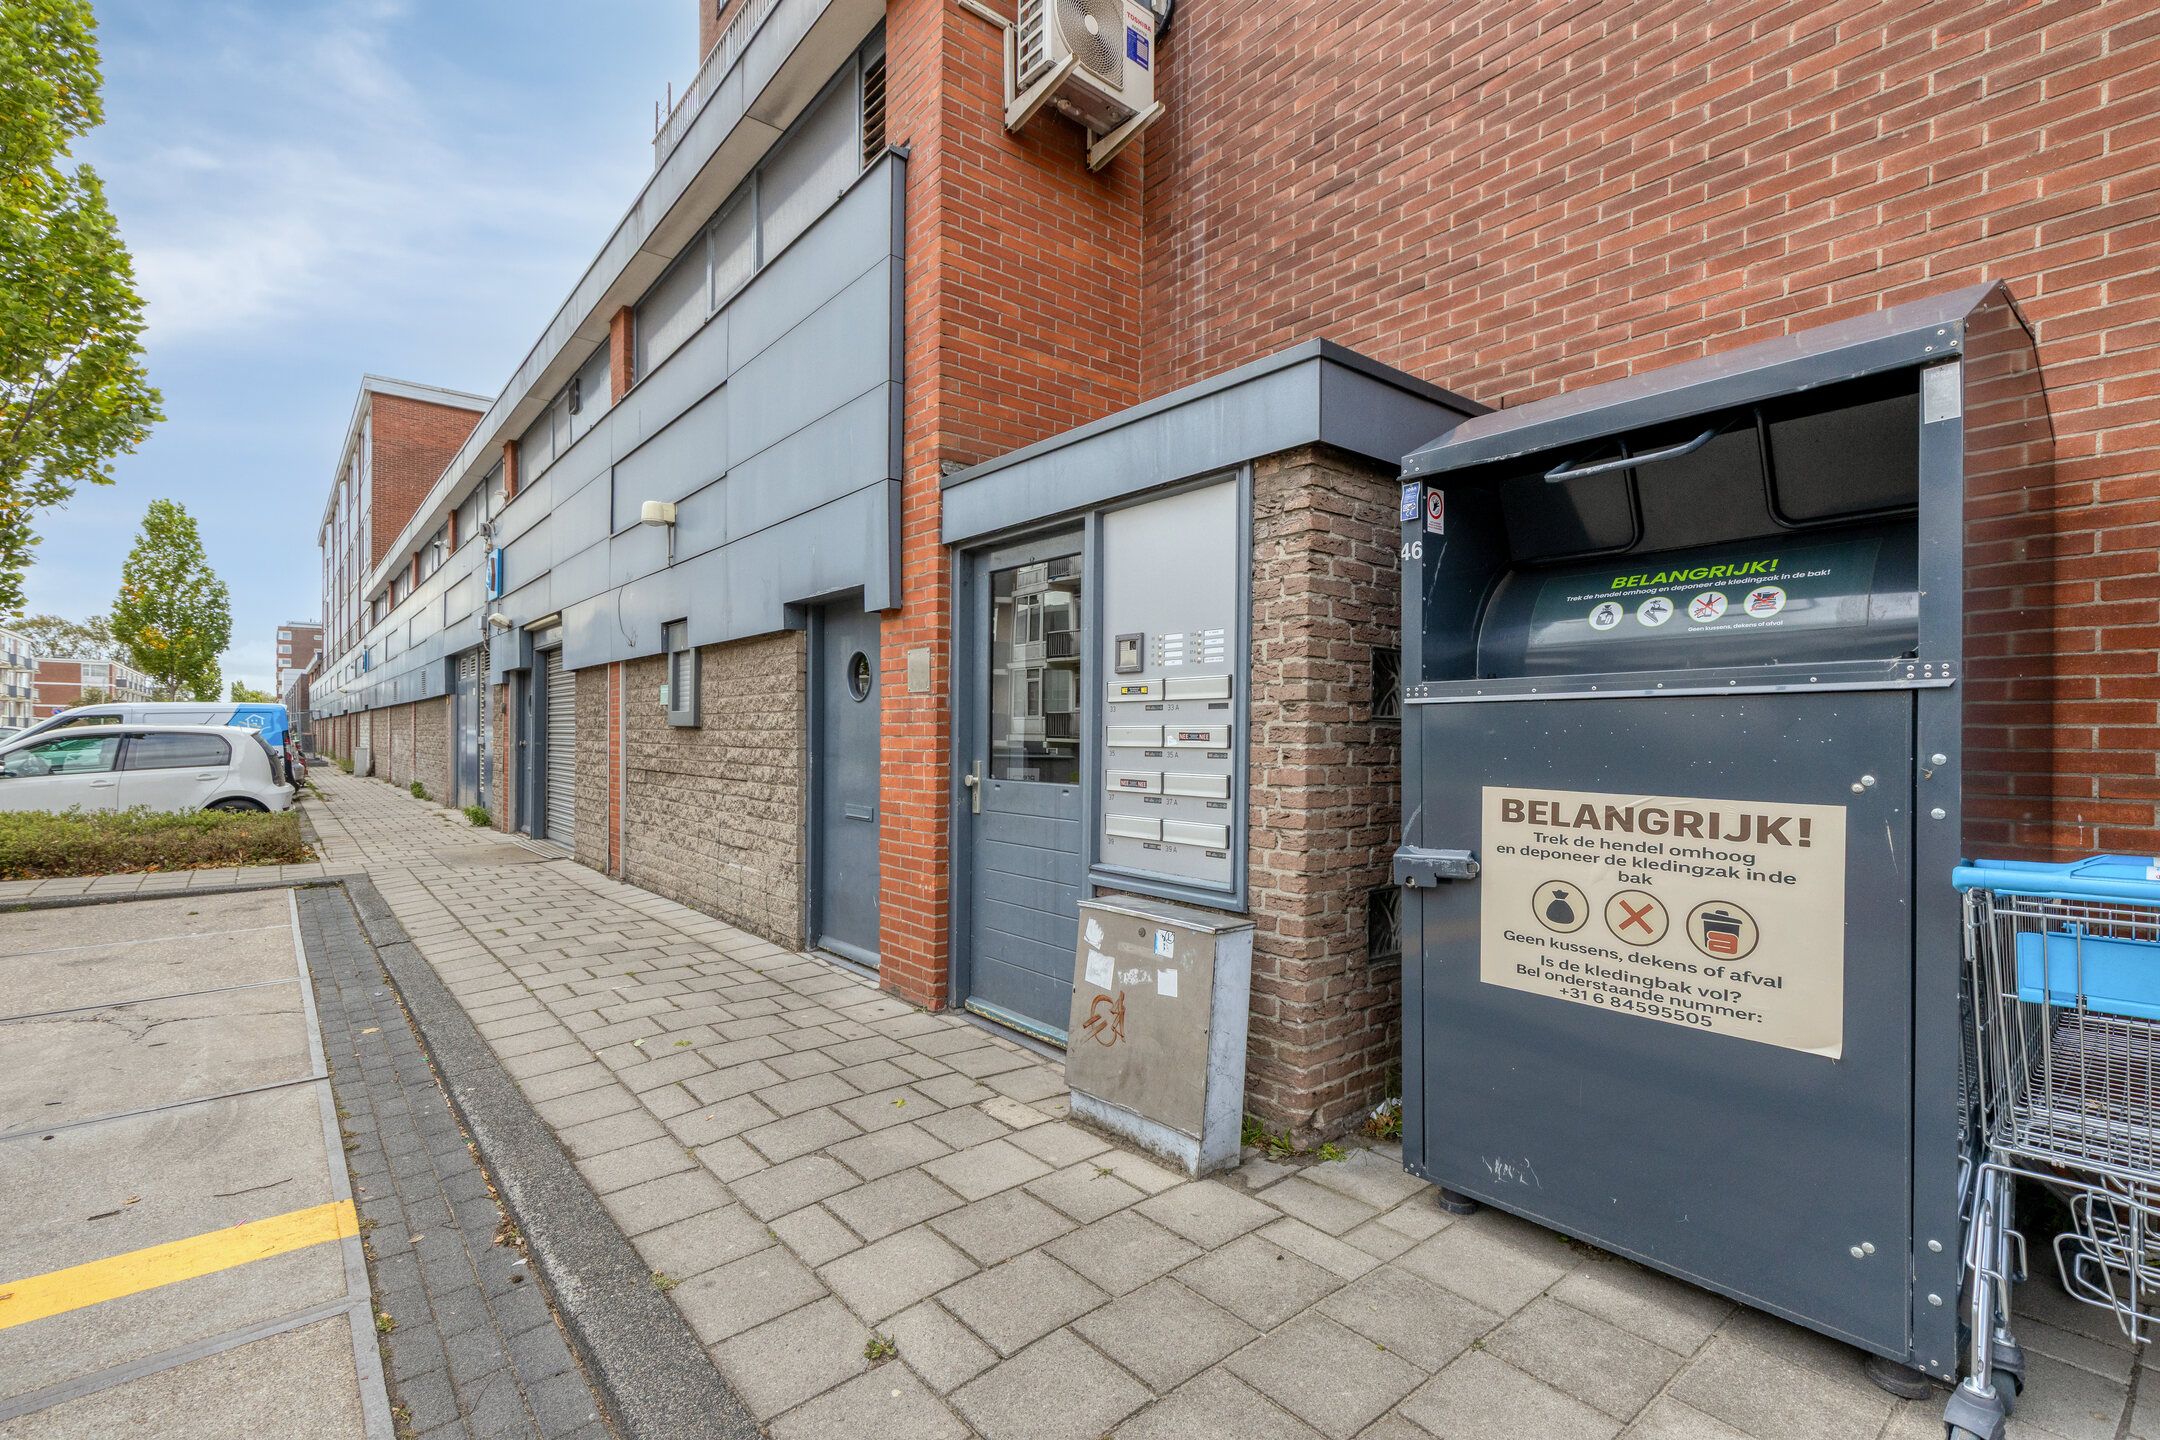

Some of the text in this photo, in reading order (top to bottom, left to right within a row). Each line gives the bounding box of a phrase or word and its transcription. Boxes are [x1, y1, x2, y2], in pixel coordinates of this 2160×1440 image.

[1127, 11, 1152, 33] TOSHIBA
[1401, 541, 1423, 560] 46
[1594, 591, 1622, 599] hendel
[1622, 588, 1657, 596] omhoog
[1671, 581, 1713, 591] deponeer
[1728, 574, 1779, 585] kledingzak
[1807, 569, 1831, 577] bak!
[1611, 559, 1779, 589] BELANGRIJK!
[1167, 703, 1175, 711] 33
[1501, 798, 1812, 848] BELANGRIJK!
[1496, 845, 1516, 854] en
[1520, 845, 1600, 863] deponeer
[1605, 854, 1627, 867] de
[1632, 856, 1741, 879] kledingzak
[1533, 832, 1756, 866] Trek de hendel omhoog
[1618, 871, 1653, 885] bak
[1503, 930, 1783, 989] Geen kussens, dekens of afval
[1516, 963, 1763, 1023] Bel onderstaande nummer:
[1540, 955, 1742, 1003] Is de kledingbak vol?
[1559, 987, 1713, 1027] +31 6 84595505
